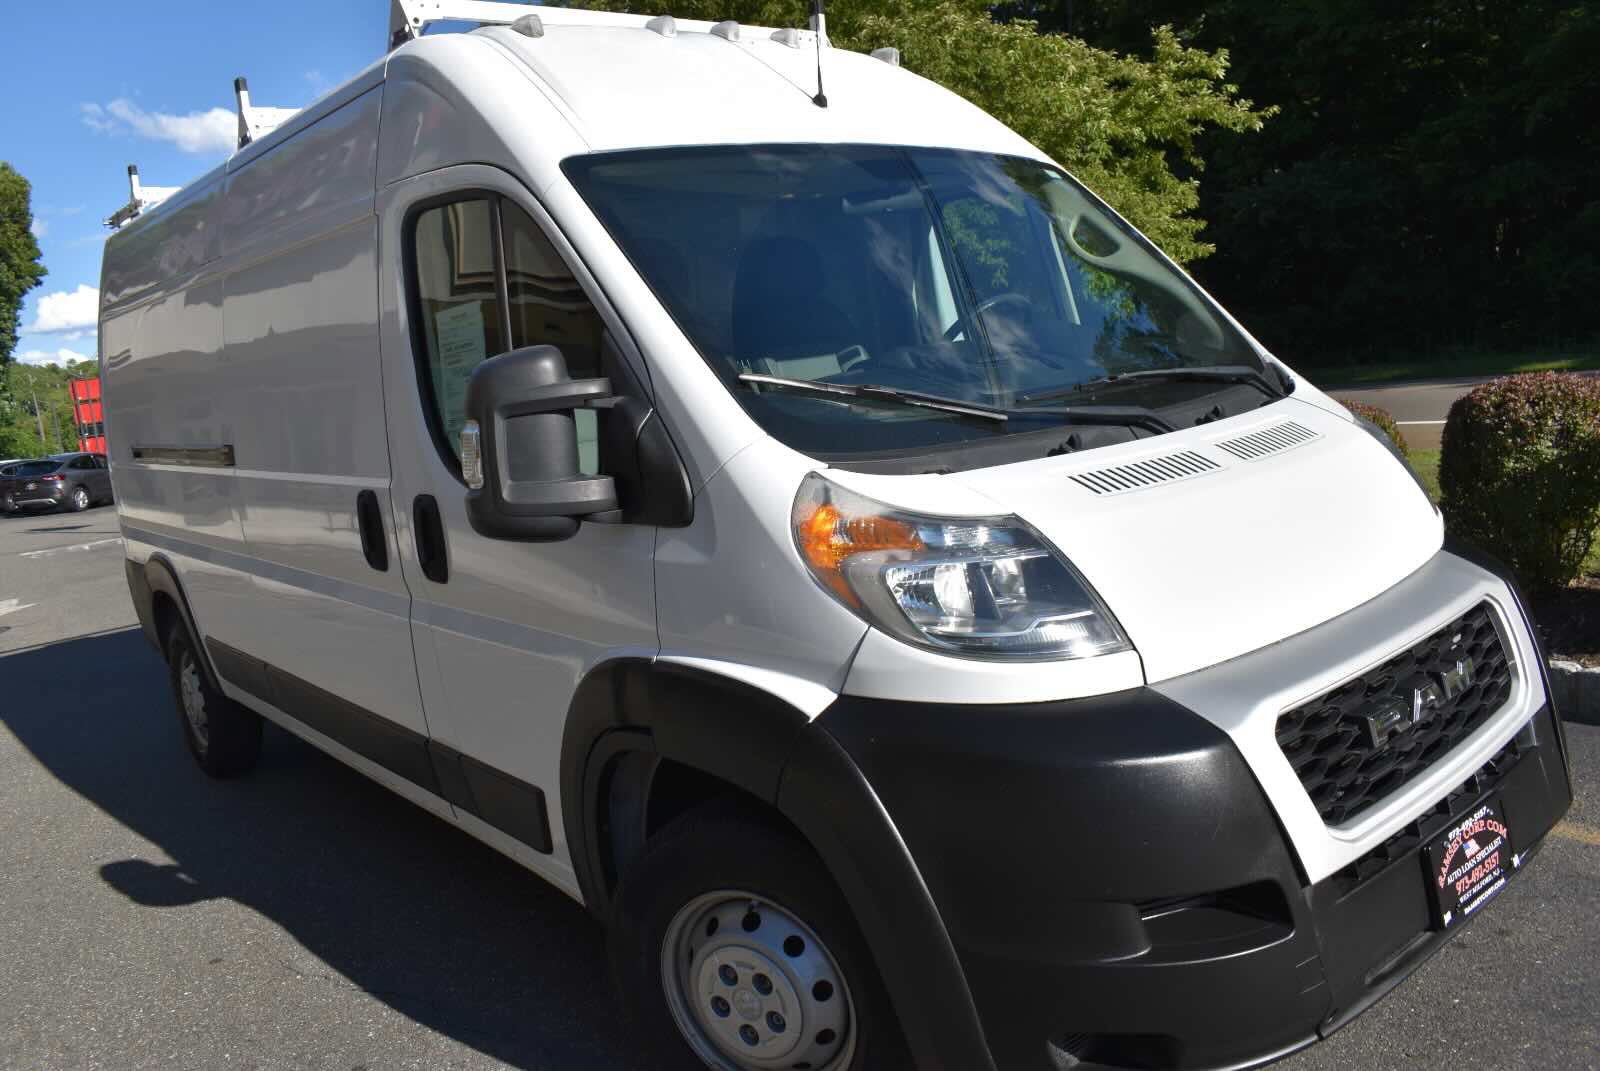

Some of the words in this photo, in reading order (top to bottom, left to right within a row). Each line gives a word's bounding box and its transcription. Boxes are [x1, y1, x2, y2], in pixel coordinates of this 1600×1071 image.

[1367, 657, 1473, 749] RAM
[1438, 832, 1463, 889] RAMSEY
[1447, 868, 1462, 886] AUTO
[1461, 857, 1477, 875] LOAN
[1475, 836, 1502, 865] SPECIALIST
[1455, 850, 1500, 896] 973-492-5157
[1459, 889, 1473, 904] WEST
